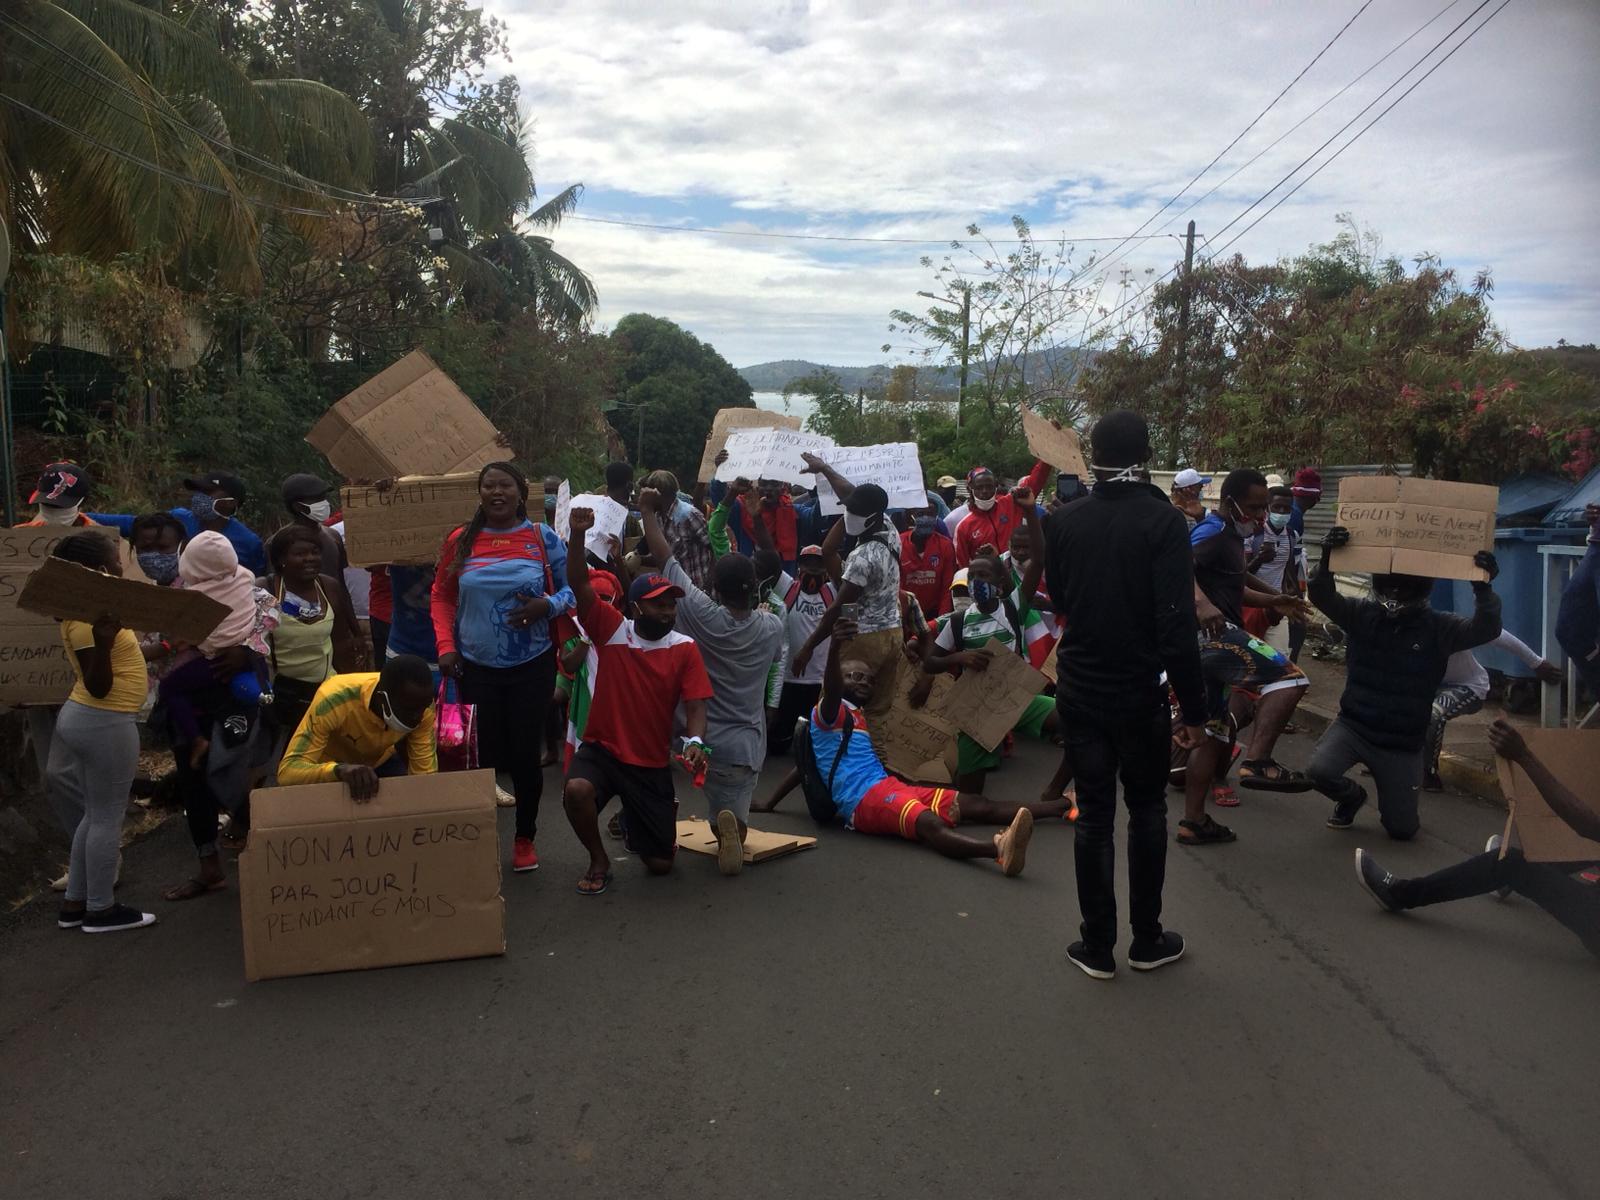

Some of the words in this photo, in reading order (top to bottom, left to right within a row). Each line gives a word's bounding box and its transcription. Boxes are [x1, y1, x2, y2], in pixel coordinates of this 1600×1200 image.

[1416, 511, 1441, 527] WE
[265, 836, 331, 872] NON
[338, 836, 355, 861] A
[366, 834, 402, 857] UN
[412, 823, 481, 847] EURO
[270, 884, 319, 906] PAR
[264, 900, 364, 942] PENDANT
[368, 898, 387, 917] 6
[394, 893, 457, 918] MOIS
